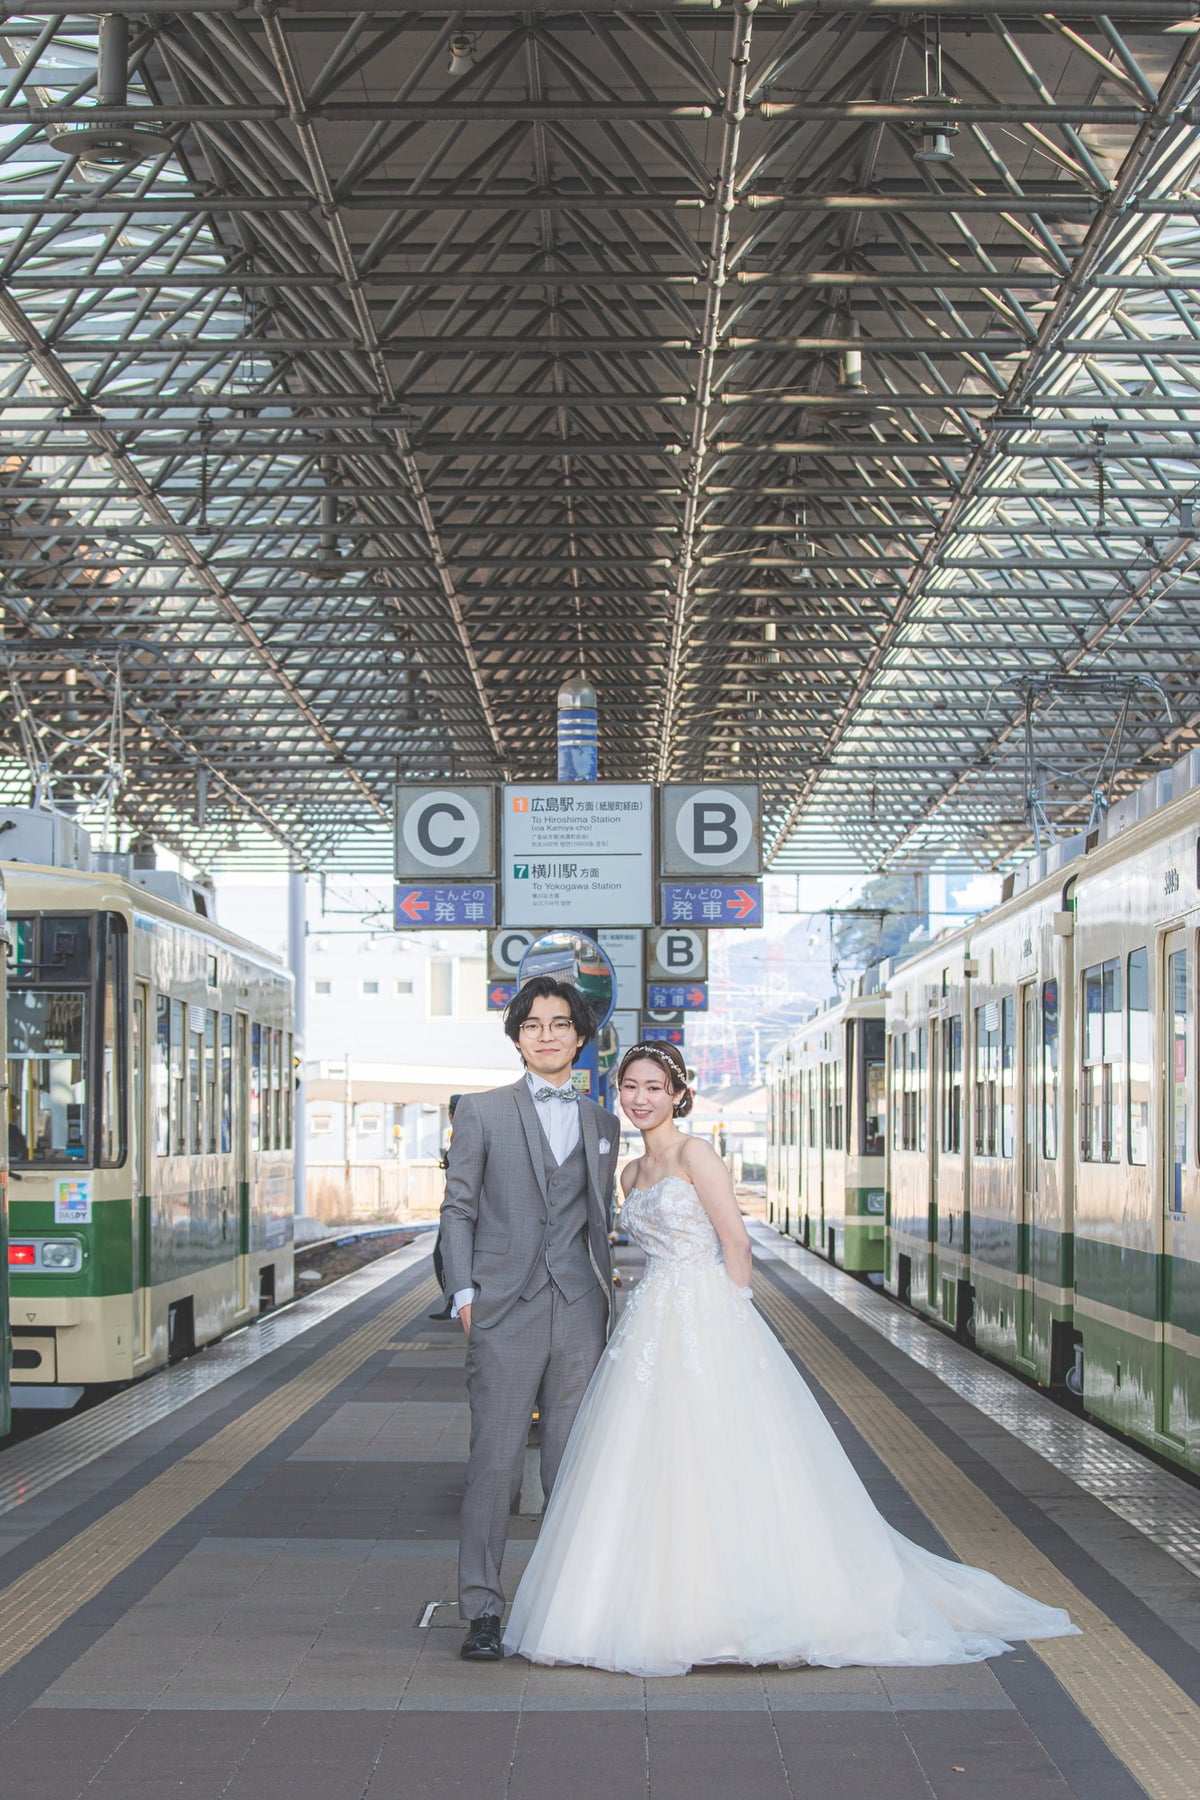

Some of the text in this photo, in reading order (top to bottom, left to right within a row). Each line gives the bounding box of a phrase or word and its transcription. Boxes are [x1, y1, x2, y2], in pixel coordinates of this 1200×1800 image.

[531, 815, 621, 824] To Hiroshima Station
[416, 803, 466, 857] C
[546, 824, 593, 833] Kamiya-cho)
[693, 803, 739, 854] B
[516, 865, 527, 878] 7
[532, 882, 622, 892] To Yokogawa Station
[434, 889, 485, 901] こんどの
[671, 888, 722, 901] こんどの
[501, 935, 530, 967] C
[667, 936, 694, 967] B
[58, 1211, 87, 1220] PASPY
